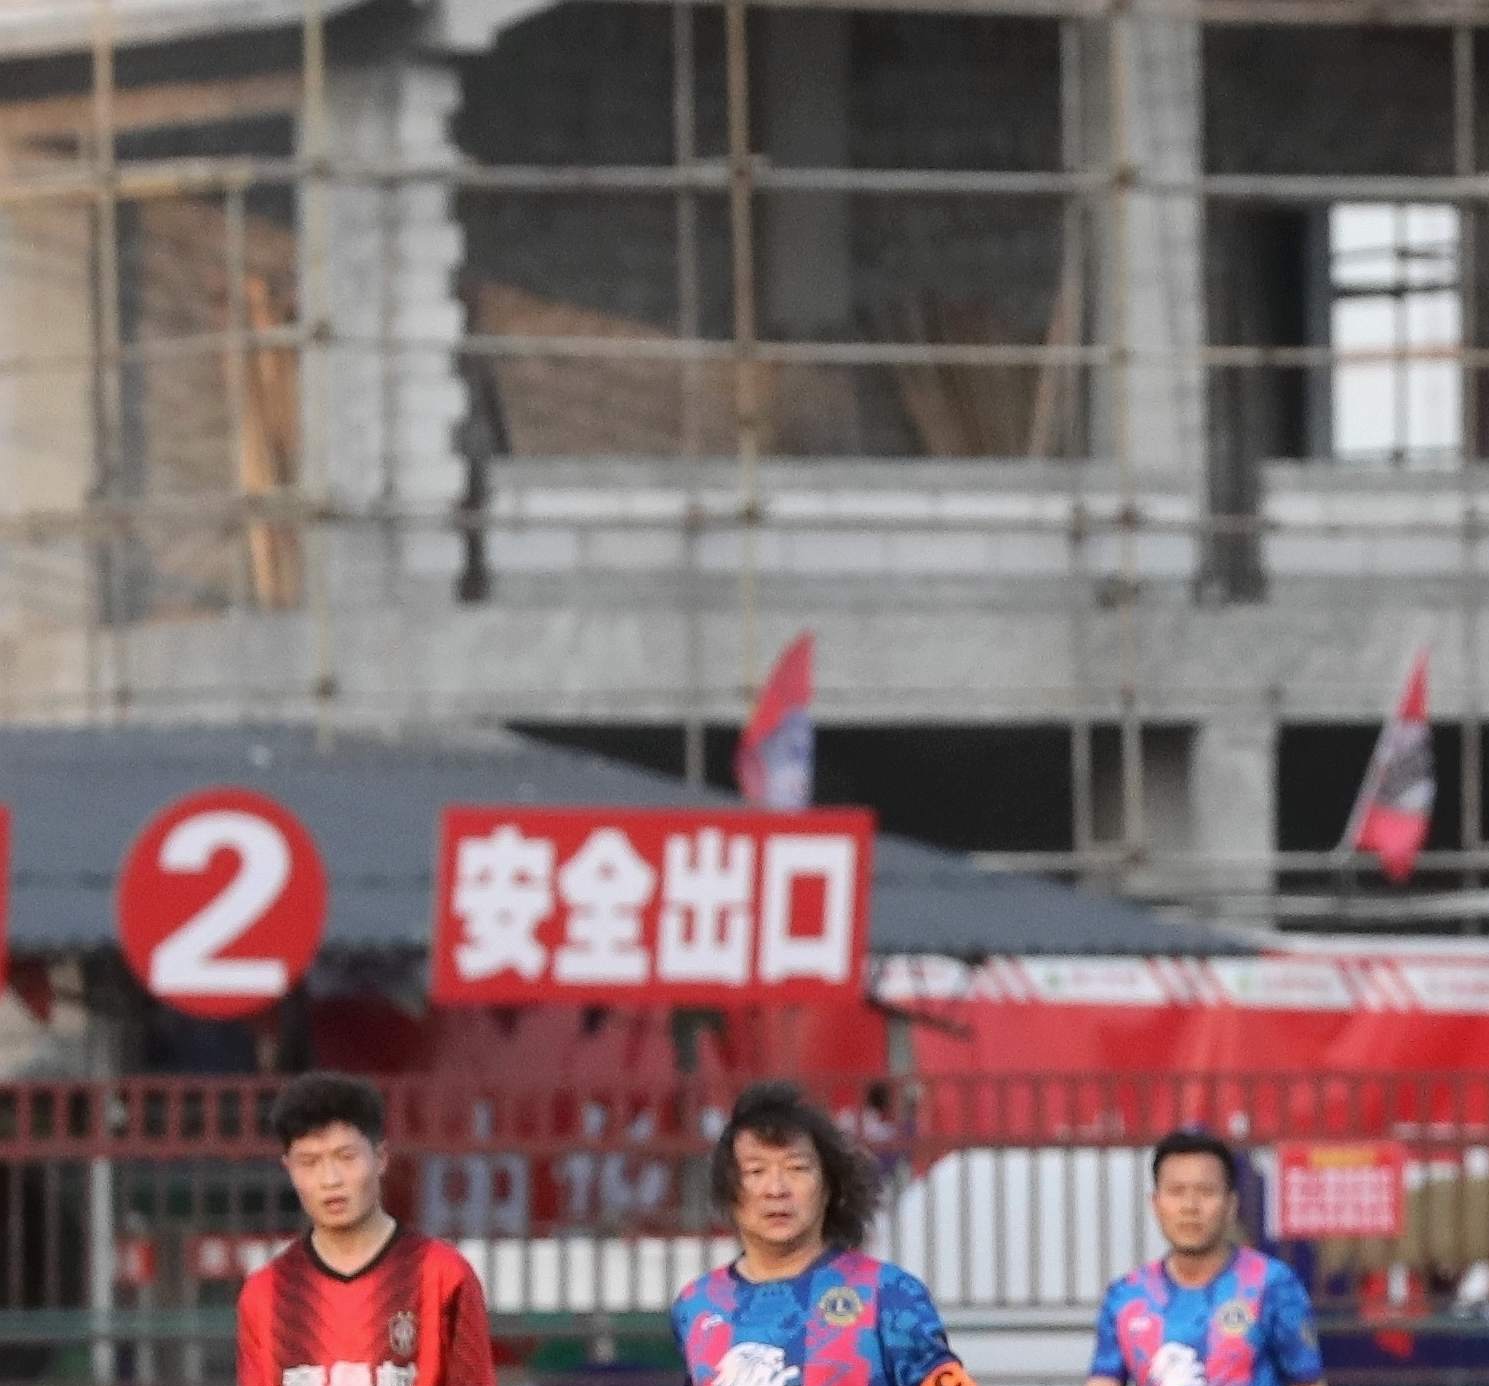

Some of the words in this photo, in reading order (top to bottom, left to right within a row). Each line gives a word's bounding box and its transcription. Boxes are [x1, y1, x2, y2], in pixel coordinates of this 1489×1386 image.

[149, 810, 292, 998] 2
[452, 825, 858, 986] 安全出口
